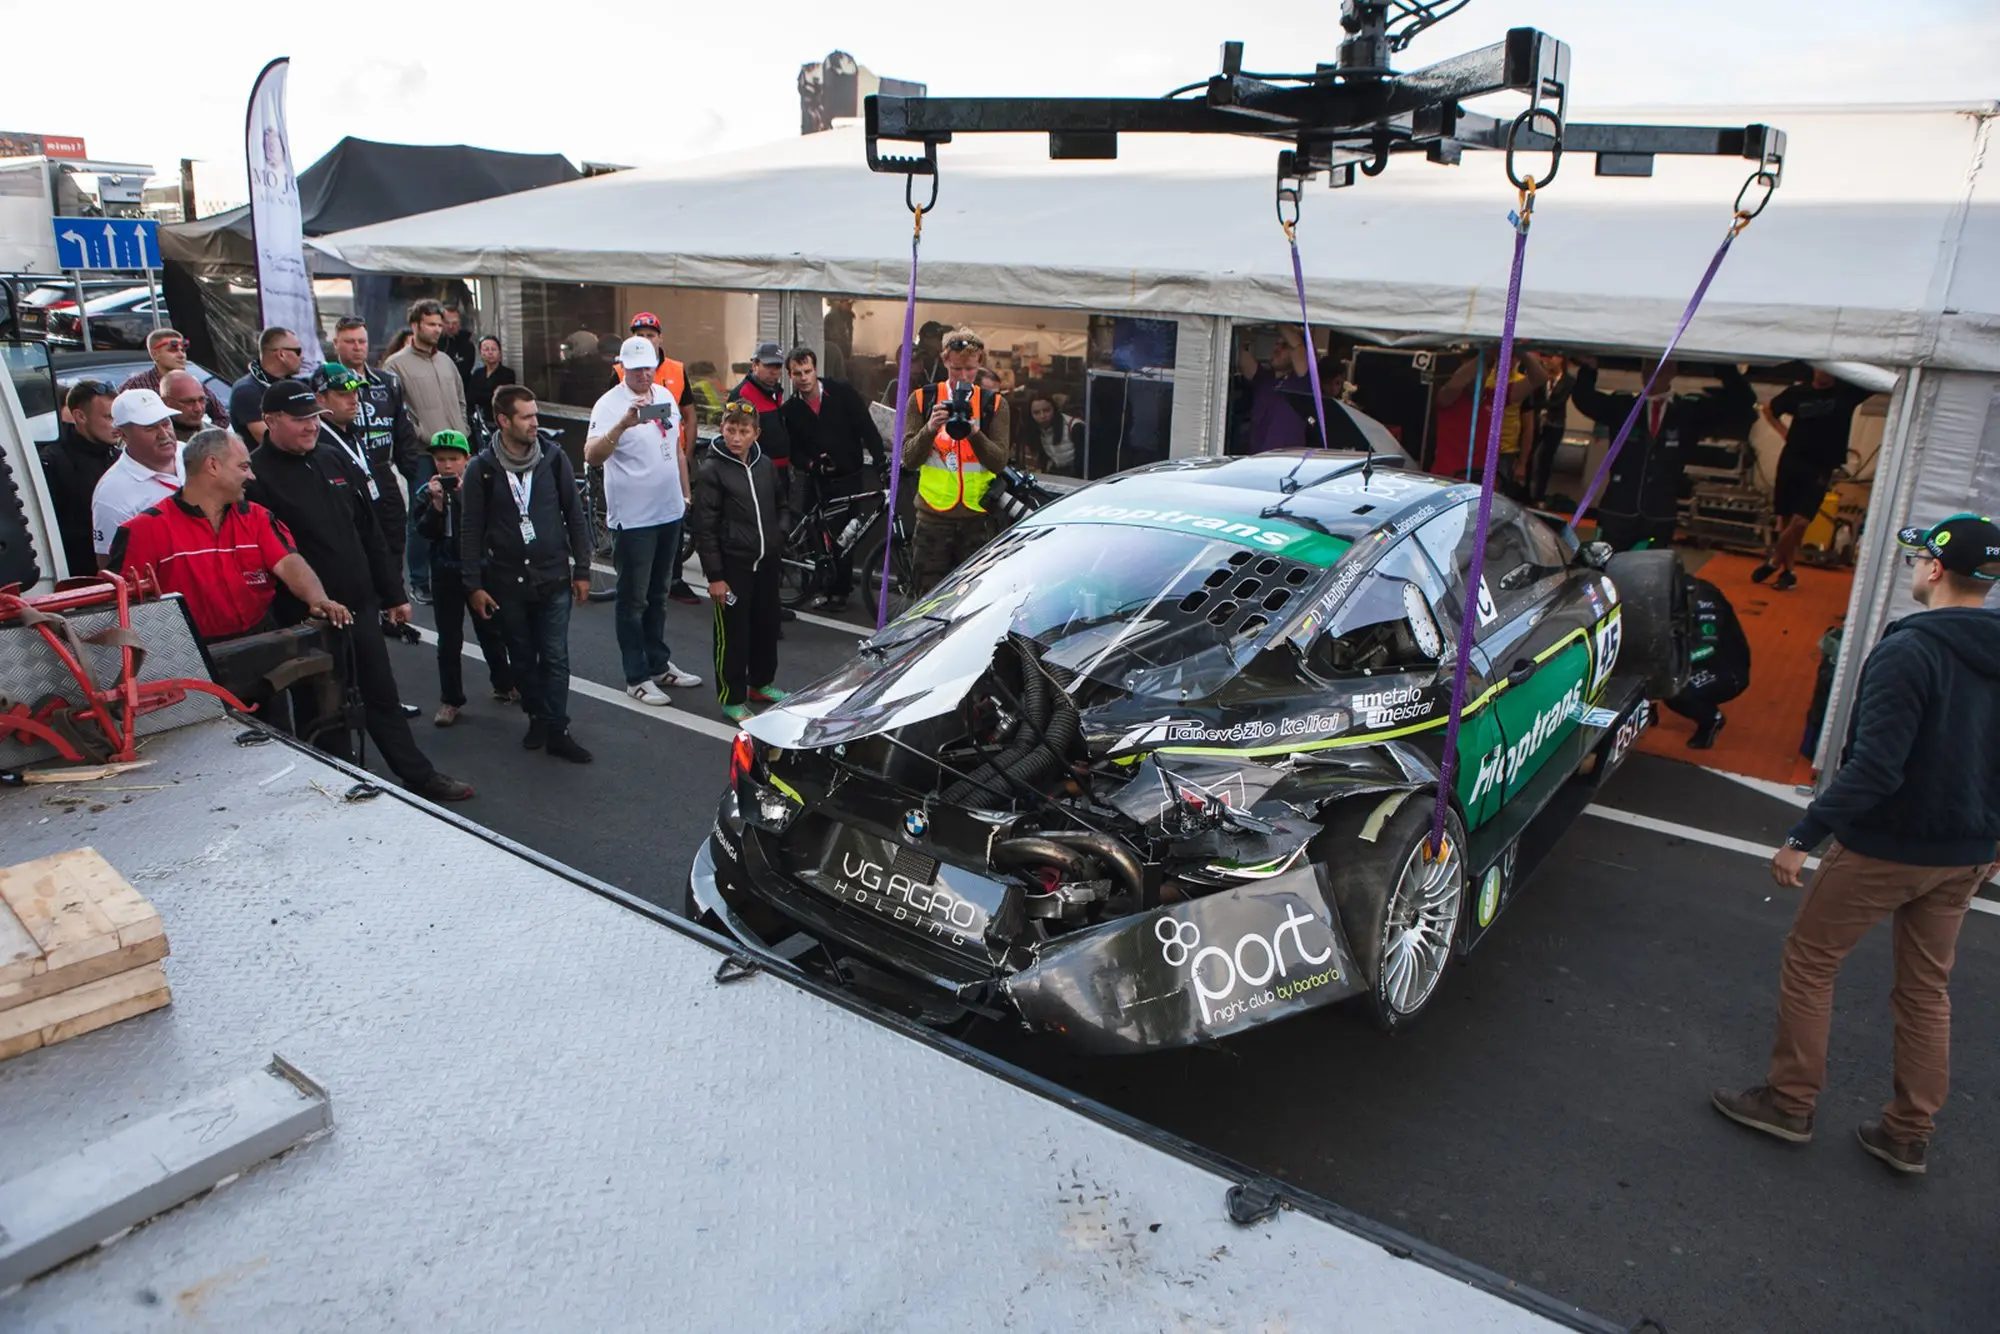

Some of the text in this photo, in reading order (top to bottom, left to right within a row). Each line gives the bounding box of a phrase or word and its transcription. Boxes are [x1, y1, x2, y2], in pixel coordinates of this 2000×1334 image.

[1065, 504, 1291, 546] Hoptrans
[1320, 559, 1363, 612] Matijošaitis
[1362, 685, 1422, 708] metalo
[1376, 698, 1436, 725] meistrai
[1279, 711, 1340, 736] keliai
[1468, 679, 1584, 806] Hoptrans
[833, 878, 967, 947] HOLDING
[842, 851, 975, 929] VG AGRO
[1190, 903, 1332, 1026] port
[1213, 1000, 1249, 1023] night
[1249, 990, 1275, 1010] club
[1275, 985, 1294, 1004] by
